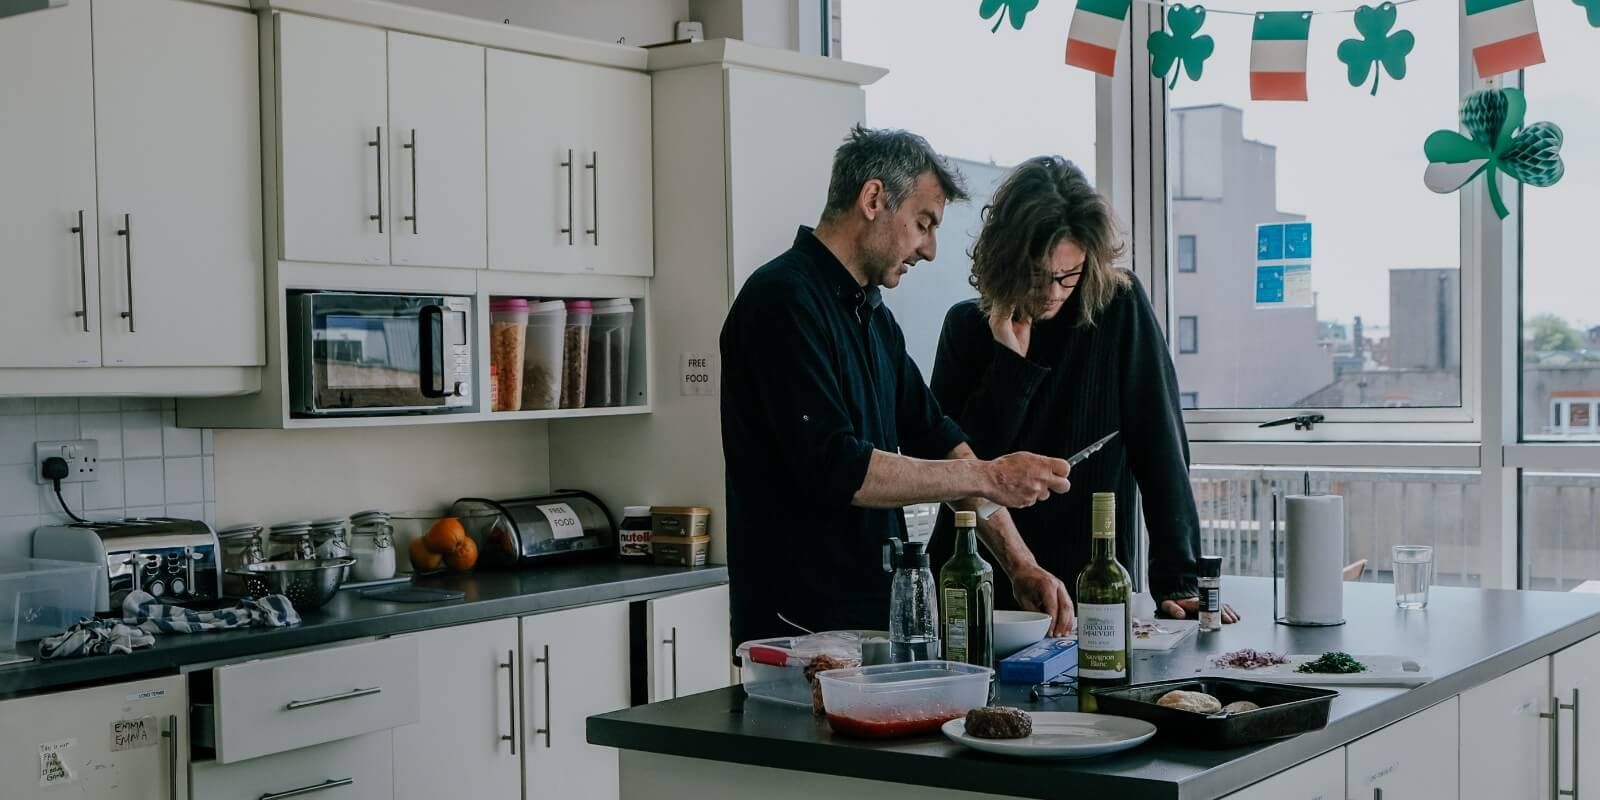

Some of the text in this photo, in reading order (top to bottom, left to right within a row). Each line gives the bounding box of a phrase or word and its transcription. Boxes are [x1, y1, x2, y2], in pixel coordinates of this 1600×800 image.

[688, 358, 706, 368] FREE
[685, 374, 709, 383] FOOD
[554, 518, 575, 527] FOOD
[1085, 653, 1115, 661] Sauvignon
[115, 720, 144, 733] EMMA
[116, 732, 147, 746] EMMA
